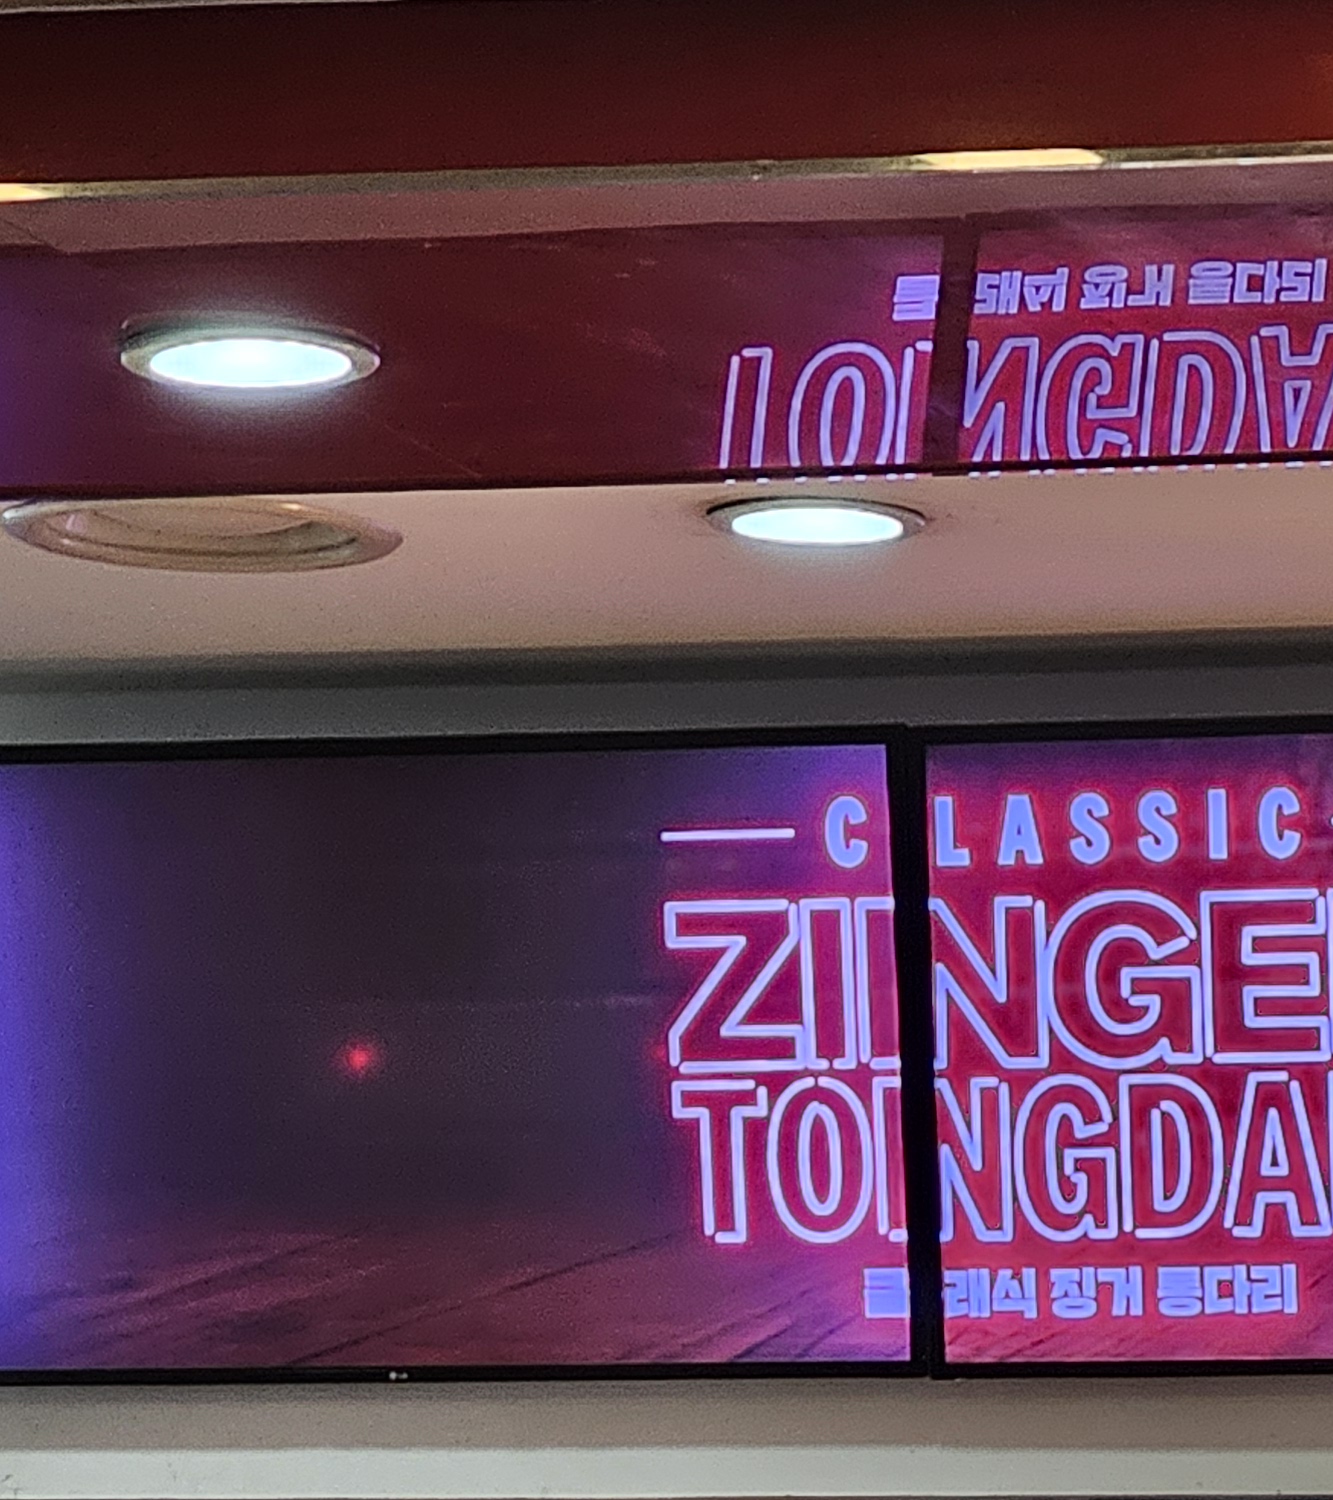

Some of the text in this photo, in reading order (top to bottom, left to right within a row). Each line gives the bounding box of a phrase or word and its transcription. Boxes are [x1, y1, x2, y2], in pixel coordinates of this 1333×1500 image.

[824, 785, 1302, 869] CLASSIC
[864, 1263, 1298, 1319] 클래식 징거 통다리
